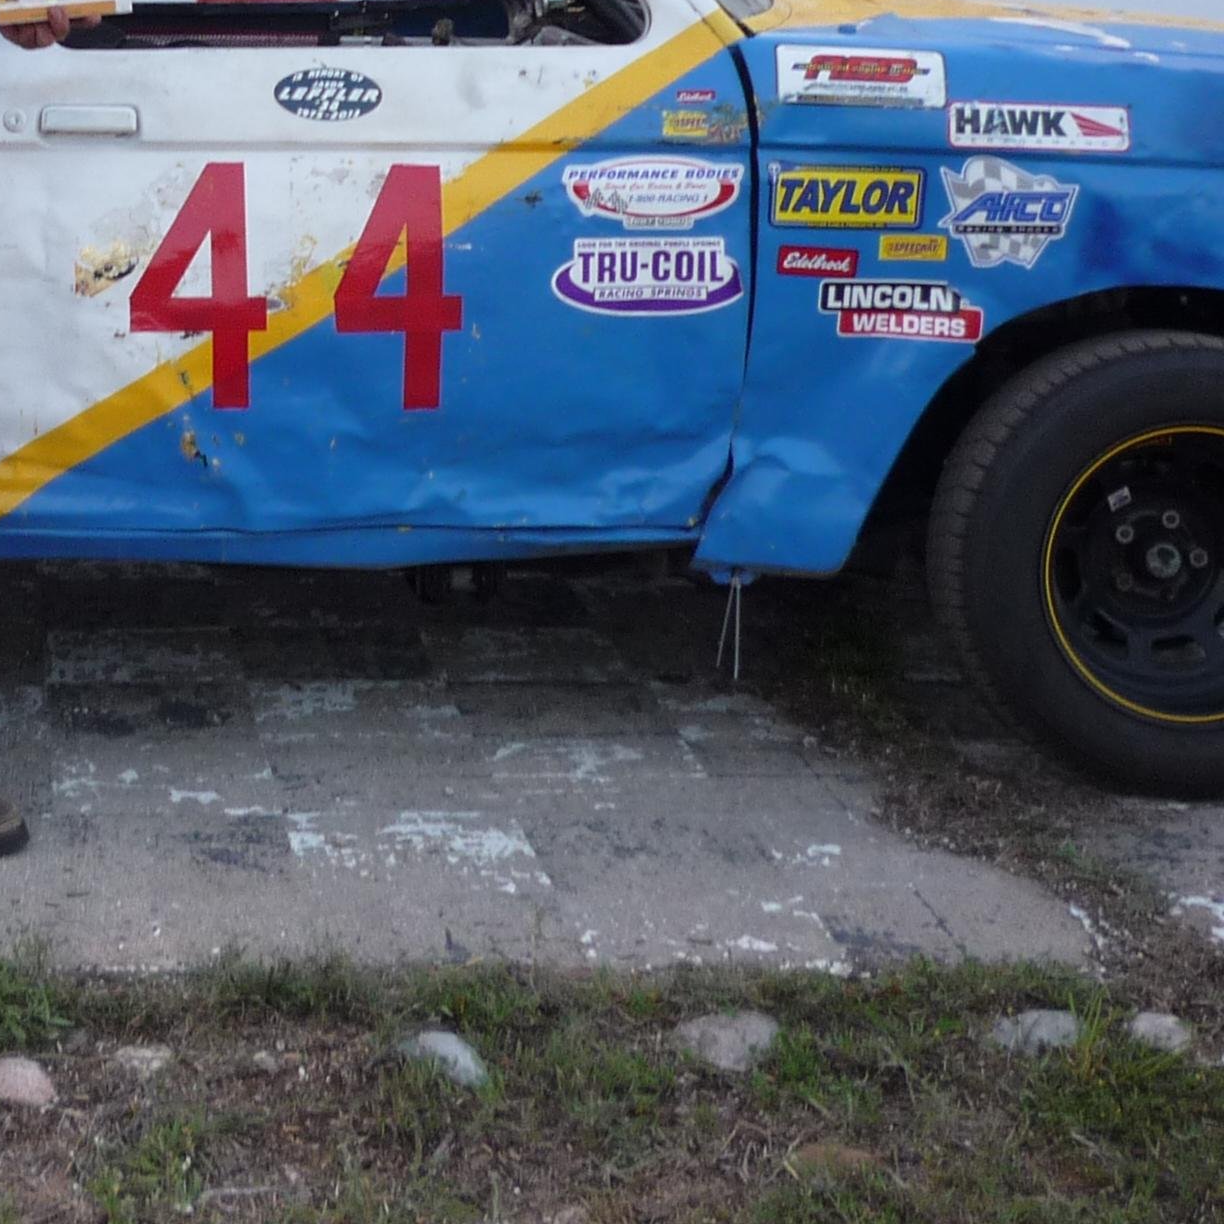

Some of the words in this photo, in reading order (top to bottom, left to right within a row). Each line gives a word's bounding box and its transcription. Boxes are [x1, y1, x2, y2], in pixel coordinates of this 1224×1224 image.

[955, 107, 1067, 137] HAWK
[568, 169, 679, 180] PERFORMANCE
[685, 168, 740, 179] BODIES
[779, 178, 915, 214] TAYLOR
[578, 250, 724, 284] TRU-COIL
[782, 251, 852, 273] Edelbrock
[599, 288, 645, 299] RACING
[650, 288, 702, 298] SPRINGS
[827, 284, 954, 311] LINCOLN
[852, 312, 966, 337] WELDERS
